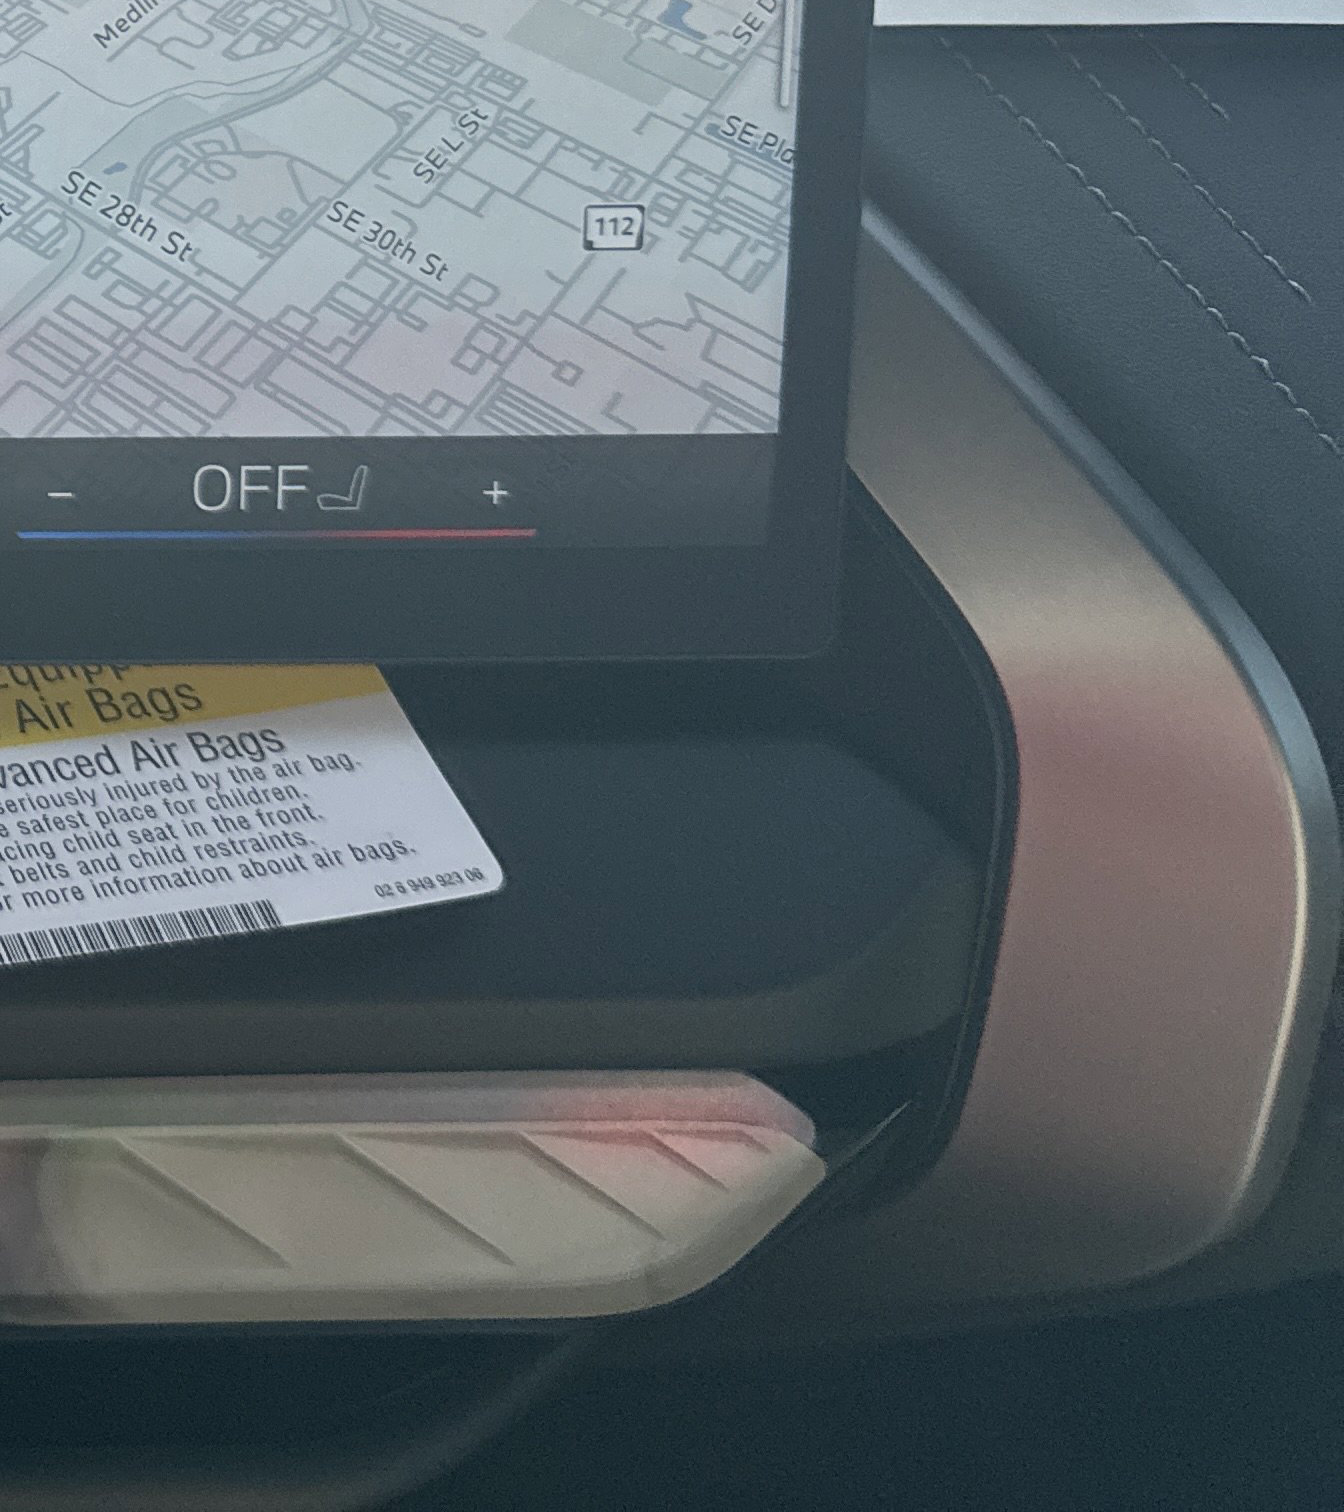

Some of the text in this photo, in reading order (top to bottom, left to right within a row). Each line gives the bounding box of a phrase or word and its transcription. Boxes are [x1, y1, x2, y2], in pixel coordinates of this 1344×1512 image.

[731, 10, 766, 47] SE
[412, 148, 448, 186] SE
[457, 104, 492, 140] St
[720, 114, 759, 146] SE
[59, 169, 196, 267] SE 28th St
[325, 199, 451, 285] SE 30th St
[594, 214, 637, 240] 112
[193, 464, 310, 513] OFF
[15, 690, 76, 735] Air
[85, 682, 204, 724] Bags
[105, 772, 189, 804] injured
[193, 769, 222, 792] by
[227, 762, 267, 786] the
[274, 755, 304, 779] air
[311, 751, 362, 776] bag.
[129, 736, 179, 775] Air
[185, 728, 287, 765] Bags
[17, 809, 90, 837] safest
[96, 801, 158, 831] place
[162, 793, 200, 818] for
[205, 781, 310, 813] children.
[62, 827, 121, 855] child
[127, 821, 178, 846] seat
[184, 814, 209, 838] in
[213, 808, 252, 835] the
[255, 801, 326, 828] front.
[10, 855, 72, 884] belts
[75, 849, 124, 877] and
[127, 843, 186, 871] child
[192, 828, 317, 863] restraints.
[21, 885, 87, 910] more
[88, 863, 236, 901] information
[240, 853, 309, 881] about
[314, 845, 345, 869] air
[348, 836, 417, 866] bags.
